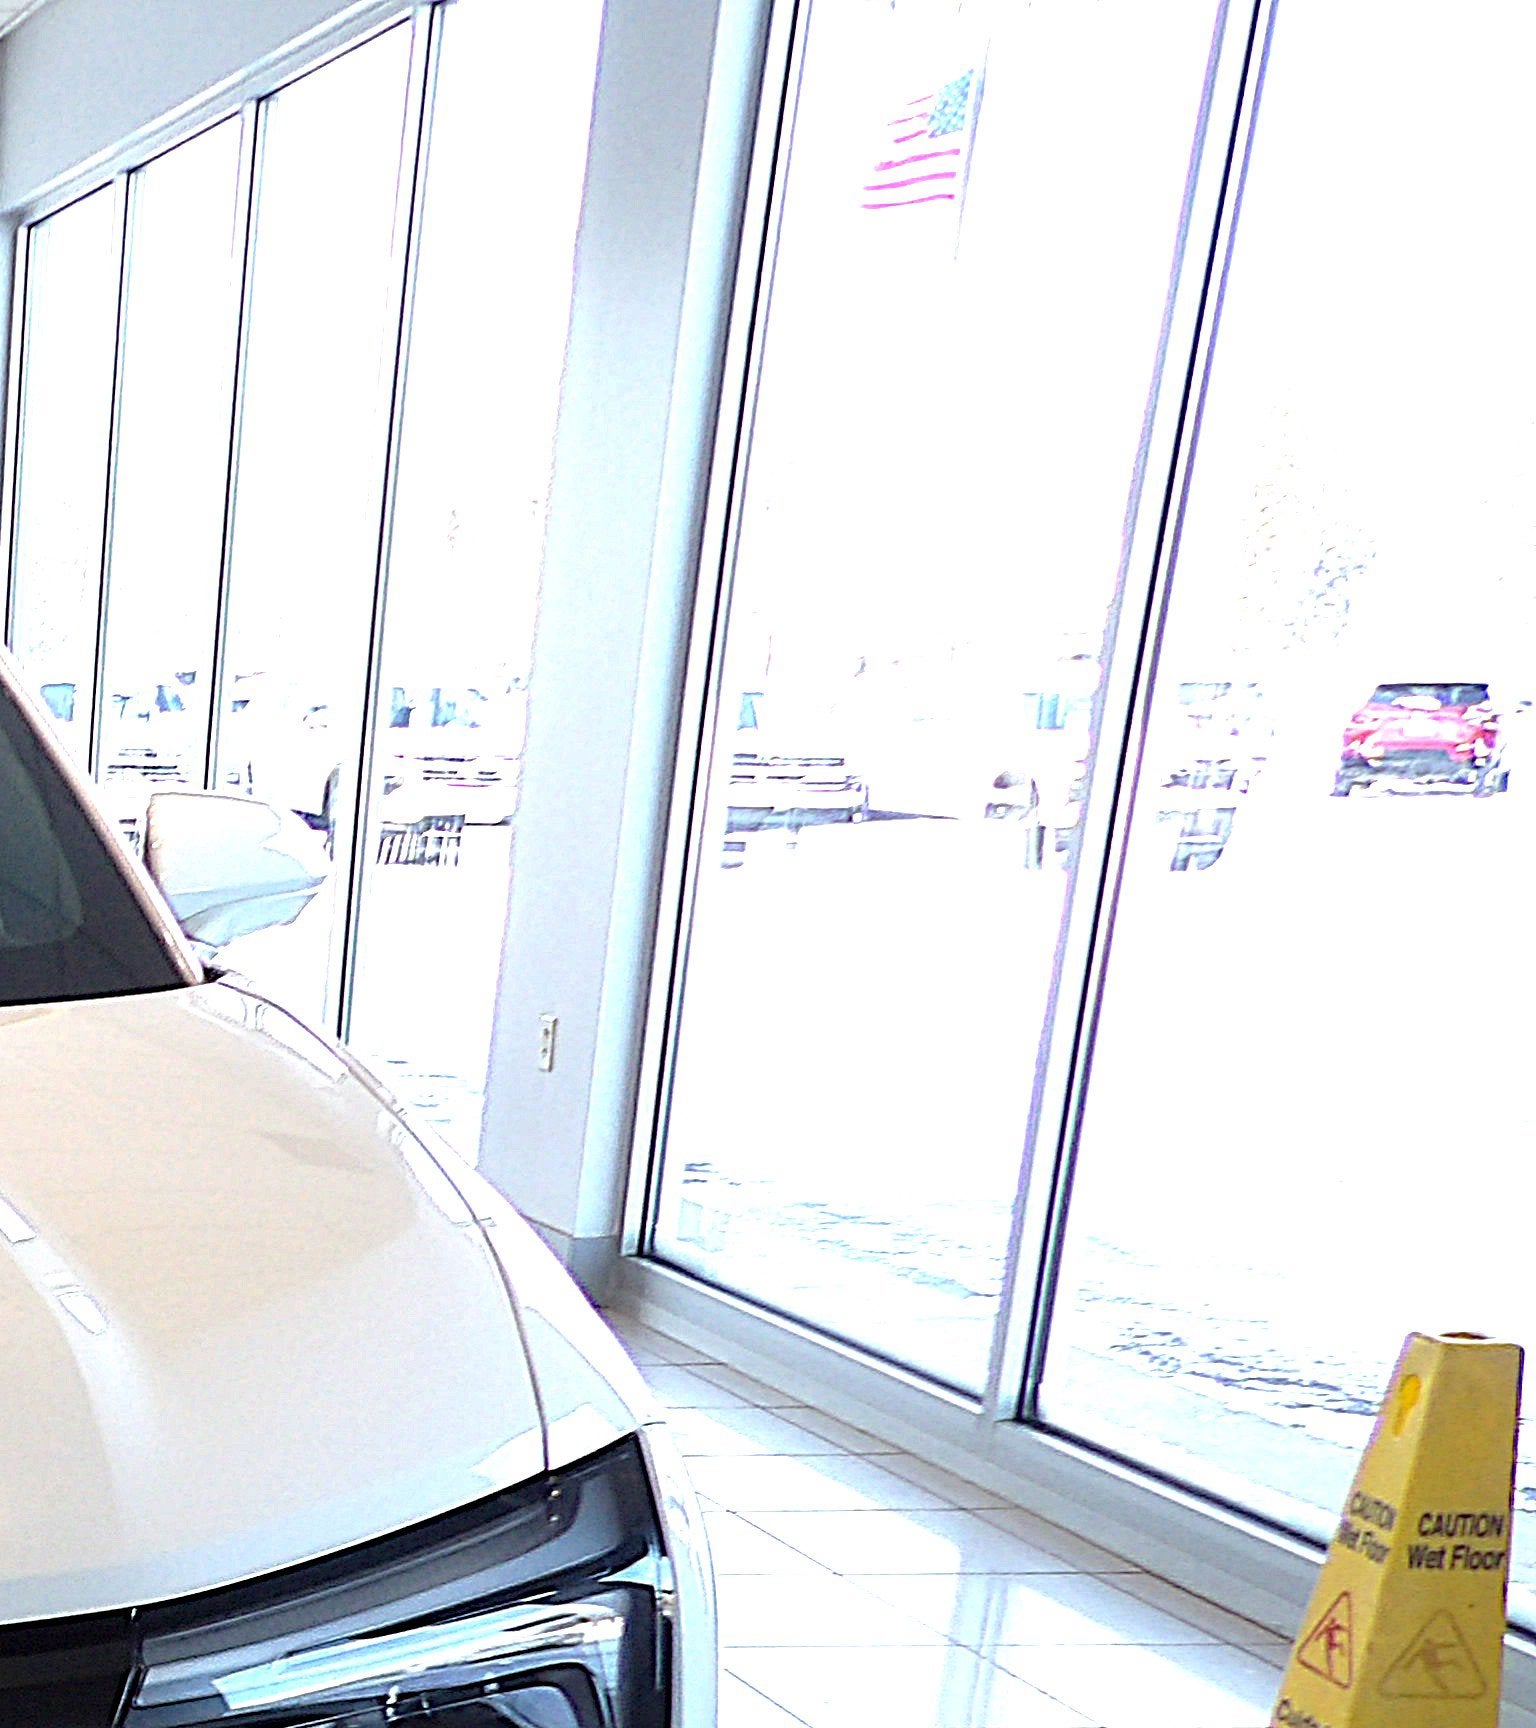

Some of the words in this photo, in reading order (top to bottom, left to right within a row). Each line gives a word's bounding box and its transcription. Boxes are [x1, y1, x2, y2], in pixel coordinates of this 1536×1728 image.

[1418, 1512, 1505, 1538] CAUTION
[1407, 1544, 1446, 1569] Wet
[1449, 1544, 1506, 1570] Floor
